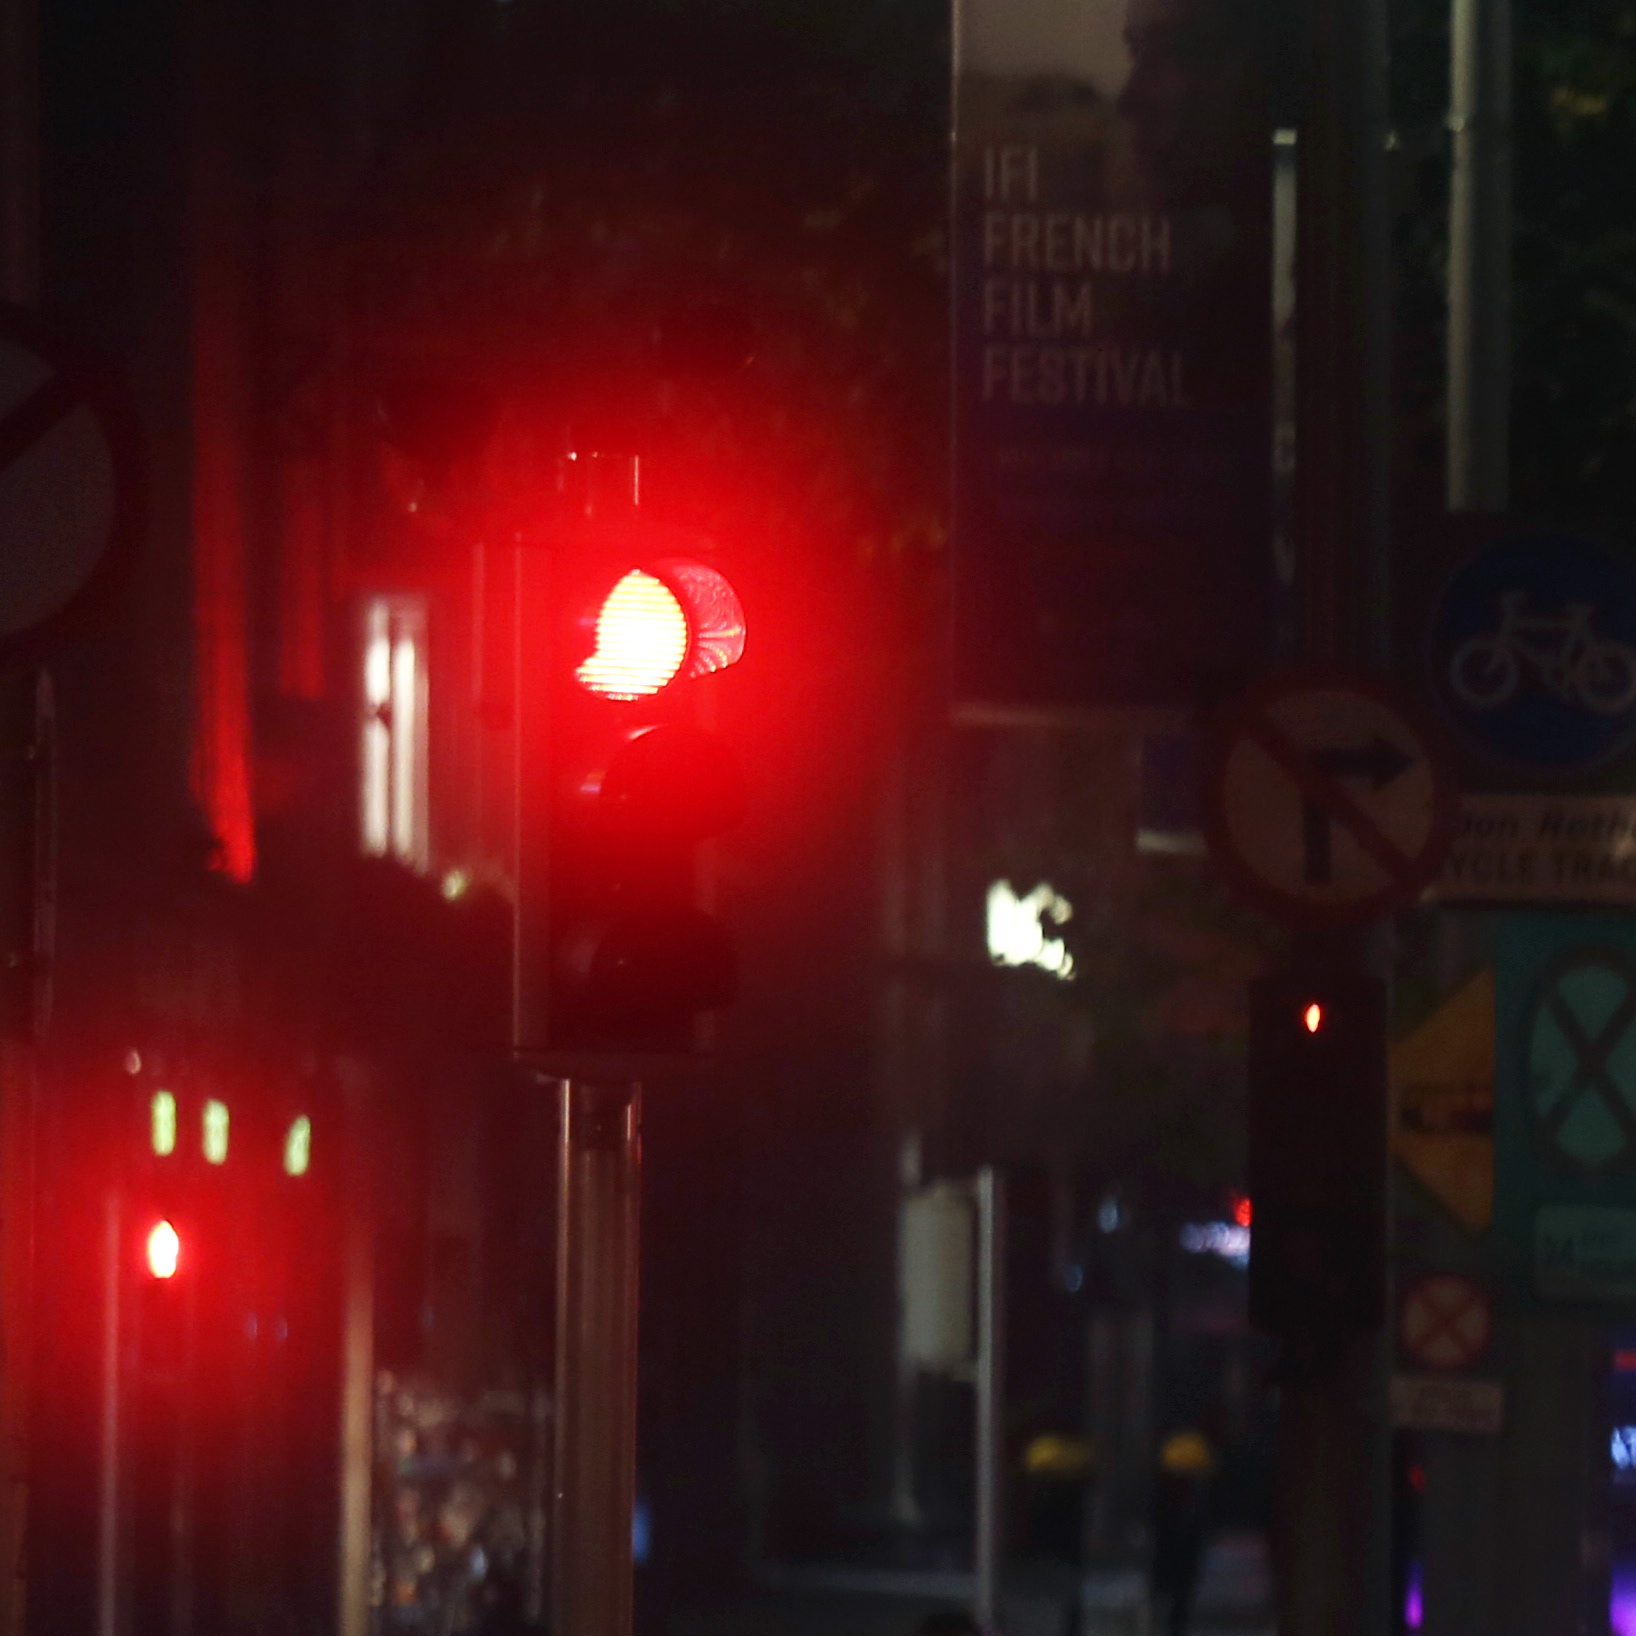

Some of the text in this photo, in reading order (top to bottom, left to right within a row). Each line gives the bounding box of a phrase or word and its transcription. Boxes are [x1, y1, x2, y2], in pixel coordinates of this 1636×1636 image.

[985, 147, 1037, 199] IFI
[985, 212, 1169, 272] FRENCH
[984, 280, 1093, 336] FILM
[983, 346, 1193, 405] FESTIVAL
[1449, 850, 1535, 884] YCLE
